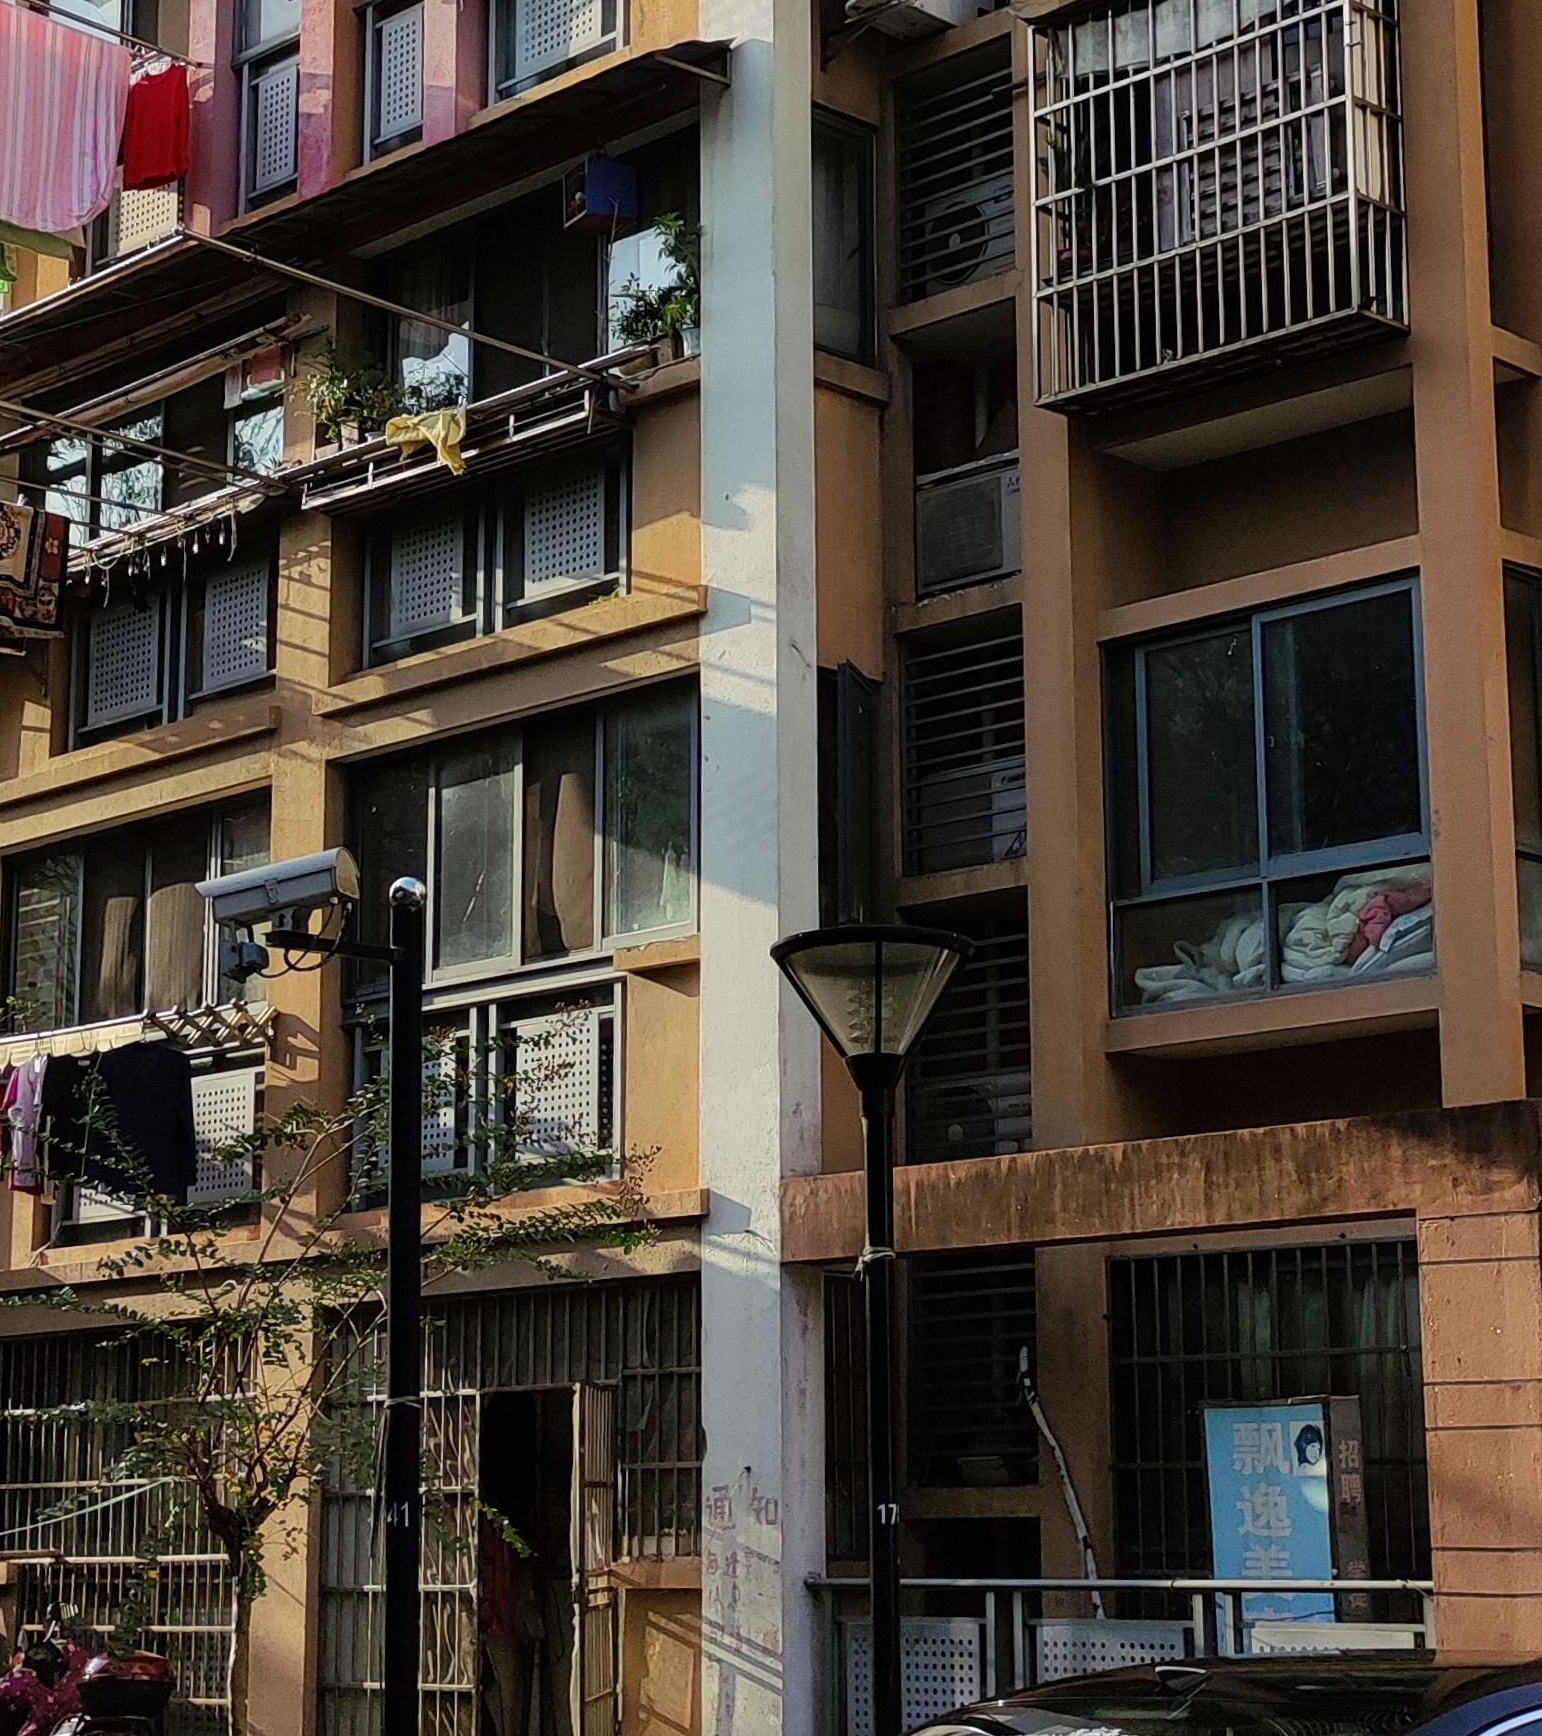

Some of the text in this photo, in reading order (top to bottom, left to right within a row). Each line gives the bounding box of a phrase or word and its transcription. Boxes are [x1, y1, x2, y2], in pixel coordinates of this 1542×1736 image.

[705, 1484, 779, 1531] 通知
[877, 1503, 900, 1525] 17
[1232, 1421, 1293, 1622] 飘逸美
